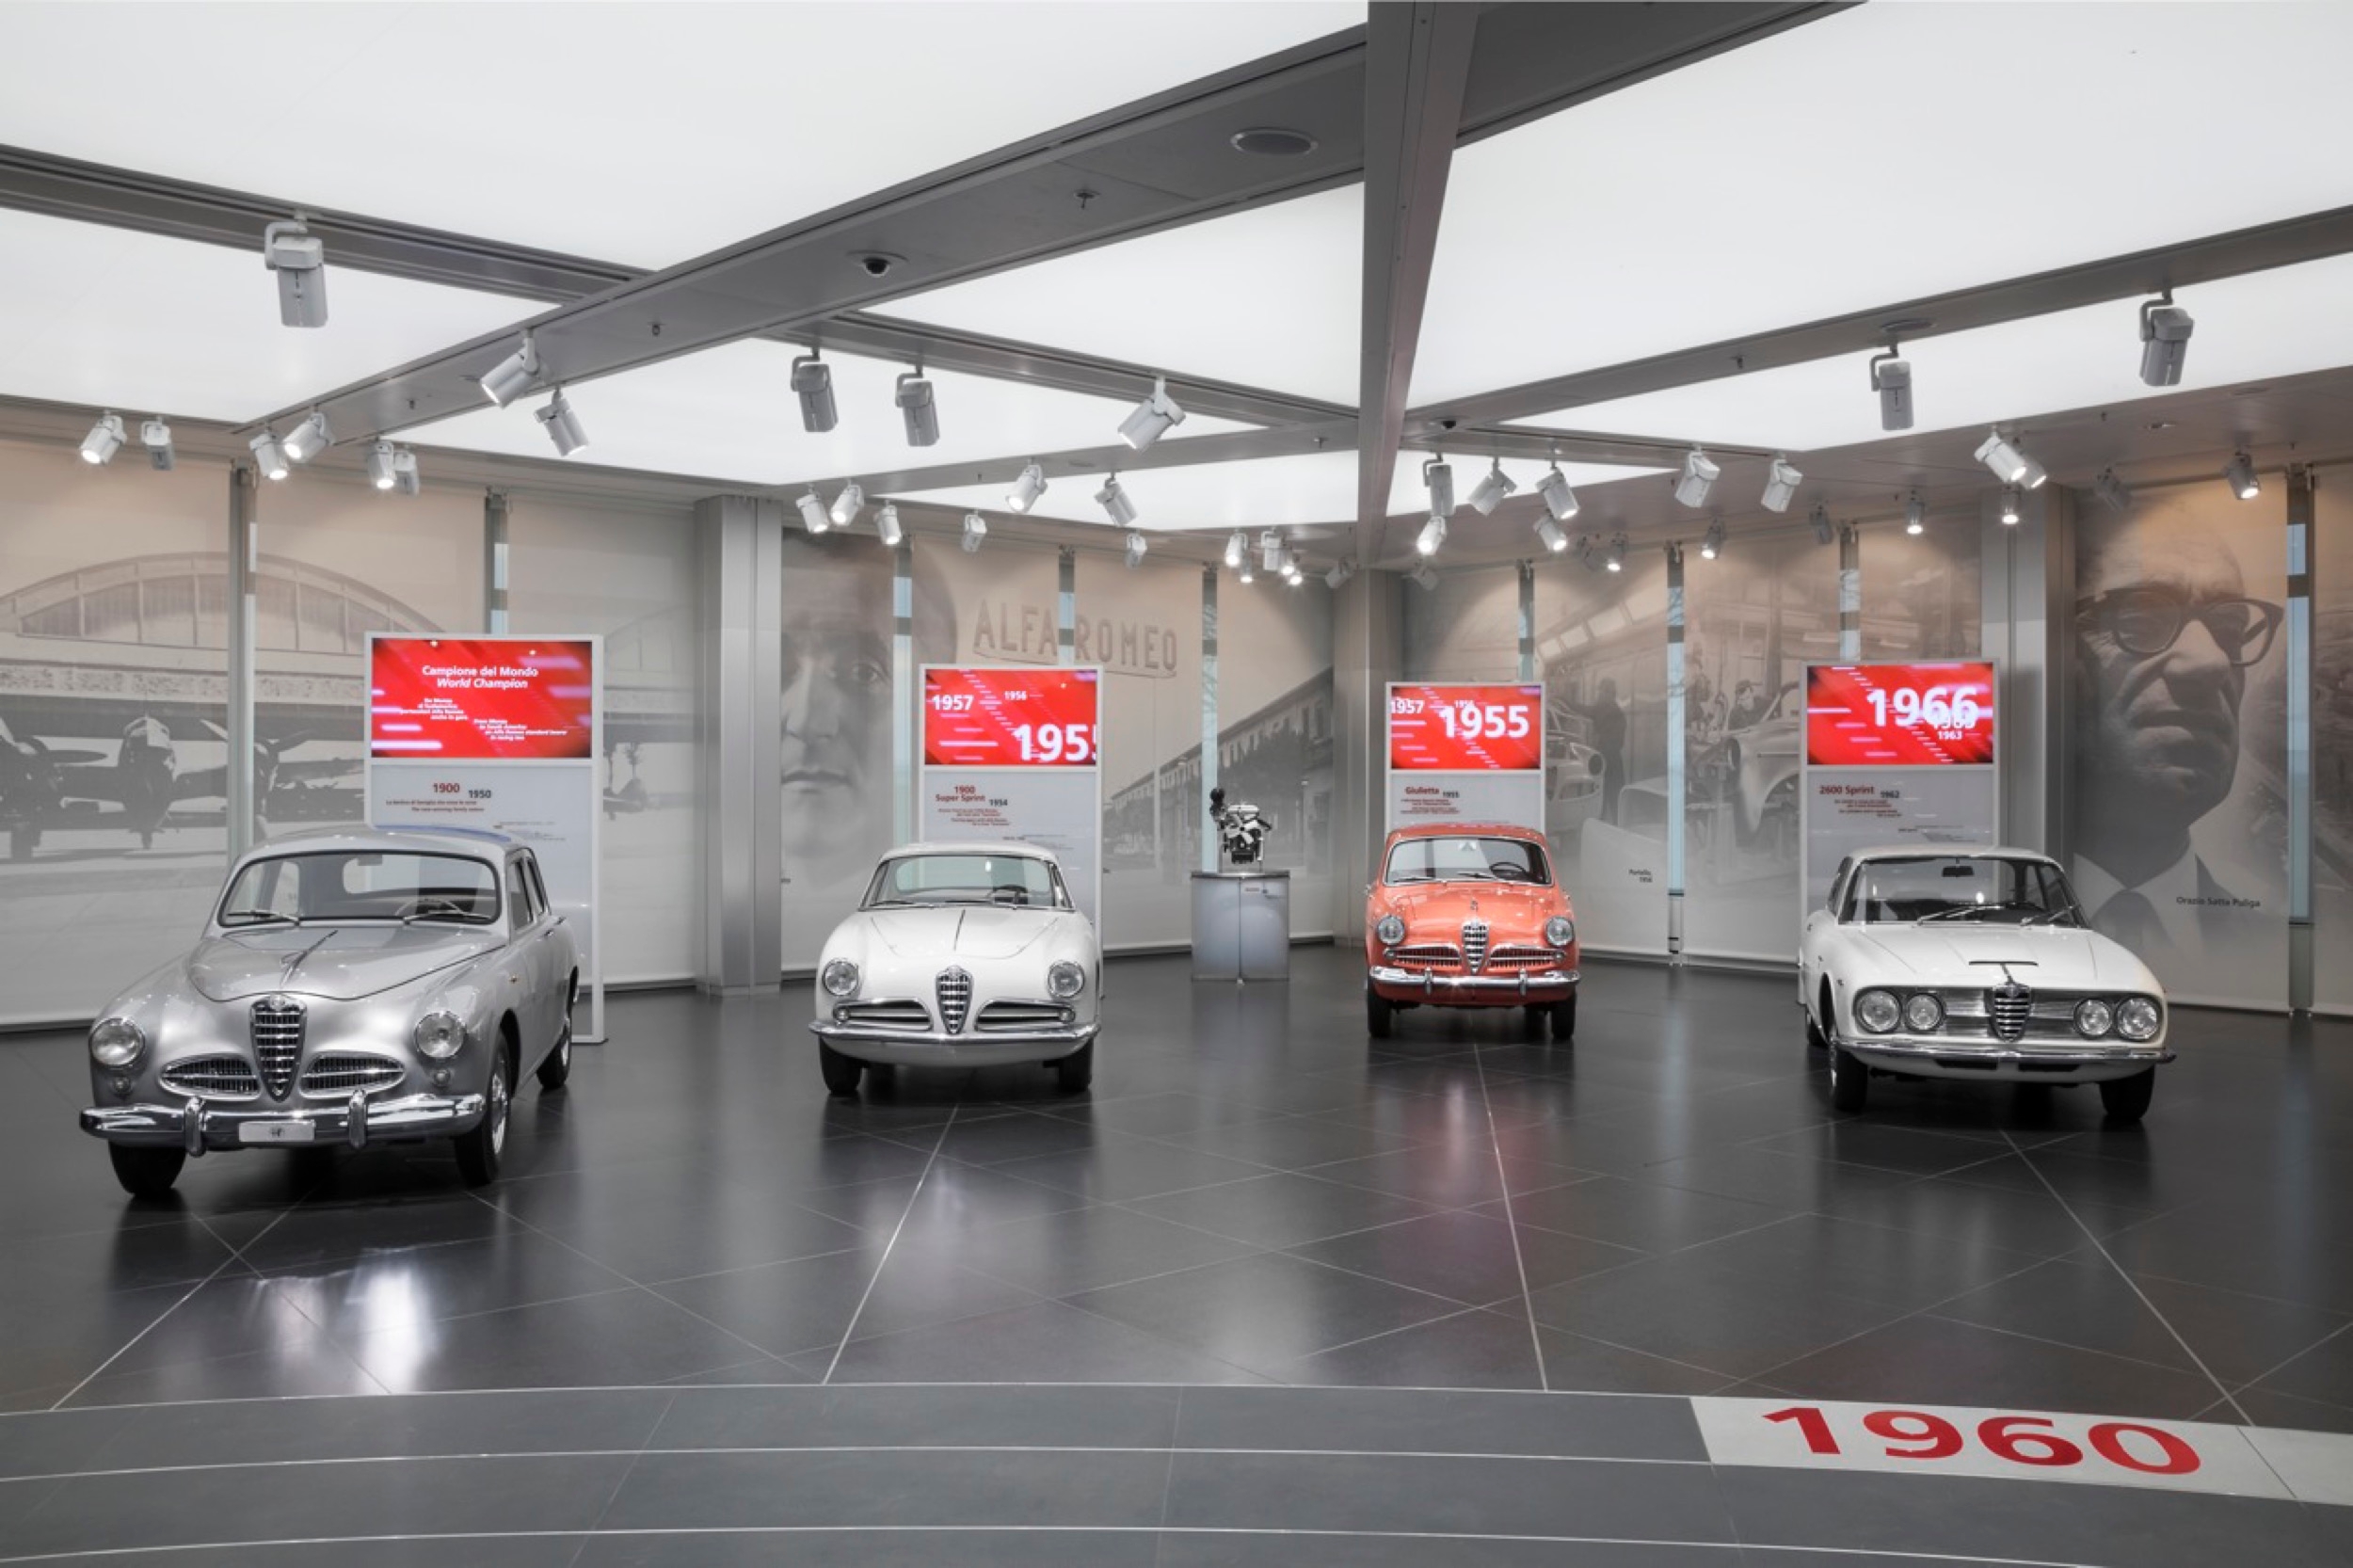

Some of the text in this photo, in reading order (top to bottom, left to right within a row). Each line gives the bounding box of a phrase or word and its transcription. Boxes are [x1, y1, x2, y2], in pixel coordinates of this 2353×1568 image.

[973, 599, 1176, 672] ALFA ROMEO
[422, 664, 538, 679] Campione del Mondo
[437, 677, 528, 690] World Champion
[1004, 691, 1027, 700] 1956
[931, 695, 974, 711] 1957
[1866, 686, 1979, 728] 1966
[1438, 705, 1529, 739] 1955
[1013, 724, 1096, 761] 195
[433, 782, 460, 793] 1900
[468, 789, 492, 799] 1950
[953, 785, 976, 794] 1900
[1405, 786, 1440, 795] Giulietta
[1819, 784, 1875, 797] 2600 Sprint
[935, 793, 985, 803] Super Sprint
[2176, 896, 2206, 906] Orazio
[2207, 896, 2231, 907] Satta
[1762, 1406, 2201, 1475] 1960
